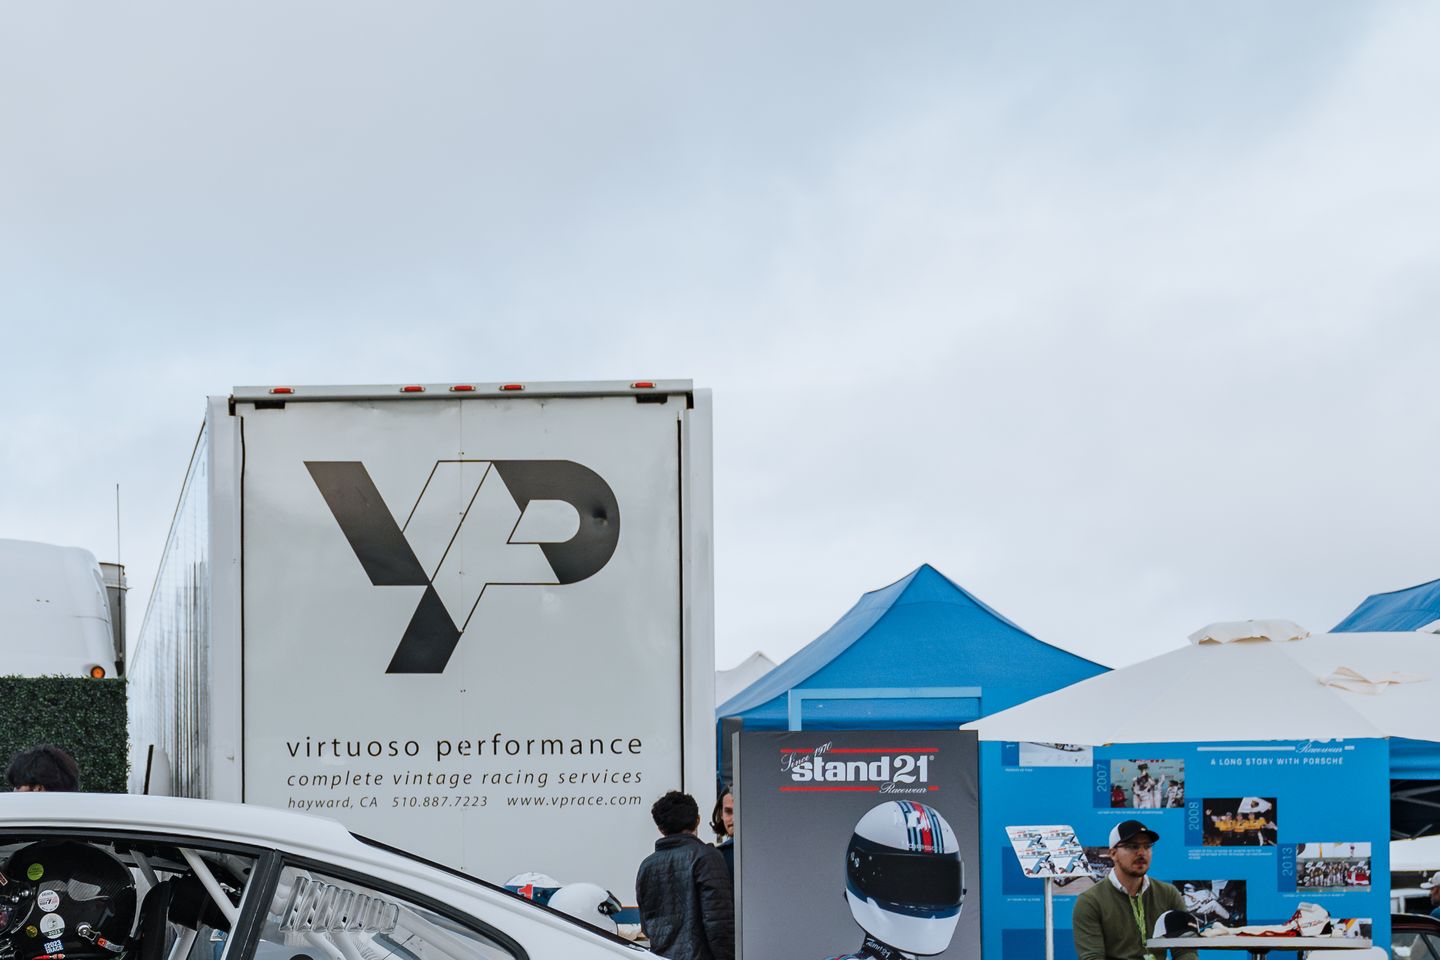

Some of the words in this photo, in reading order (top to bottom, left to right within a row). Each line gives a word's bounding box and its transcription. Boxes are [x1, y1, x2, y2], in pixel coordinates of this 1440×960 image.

[287, 736, 420, 757] virtuoso
[437, 733, 642, 761] performance
[1246, 758, 1273, 766] STORY
[1277, 758, 1300, 766] WITH
[1303, 757, 1343, 765] PORSCHE
[287, 771, 383, 789] complete
[393, 771, 472, 788] vintage
[482, 770, 548, 788] racing
[558, 769, 642, 784] services
[879, 782, 927, 794] Racewear
[1096, 763, 1108, 792] 2007
[288, 797, 354, 811] hayward,
[360, 797, 378, 808] CA
[392, 796, 488, 807] 510.887.7223
[507, 795, 642, 809] www.vprace.com
[1188, 801, 1199, 831] 2008
[1281, 847, 1293, 876] 2013
